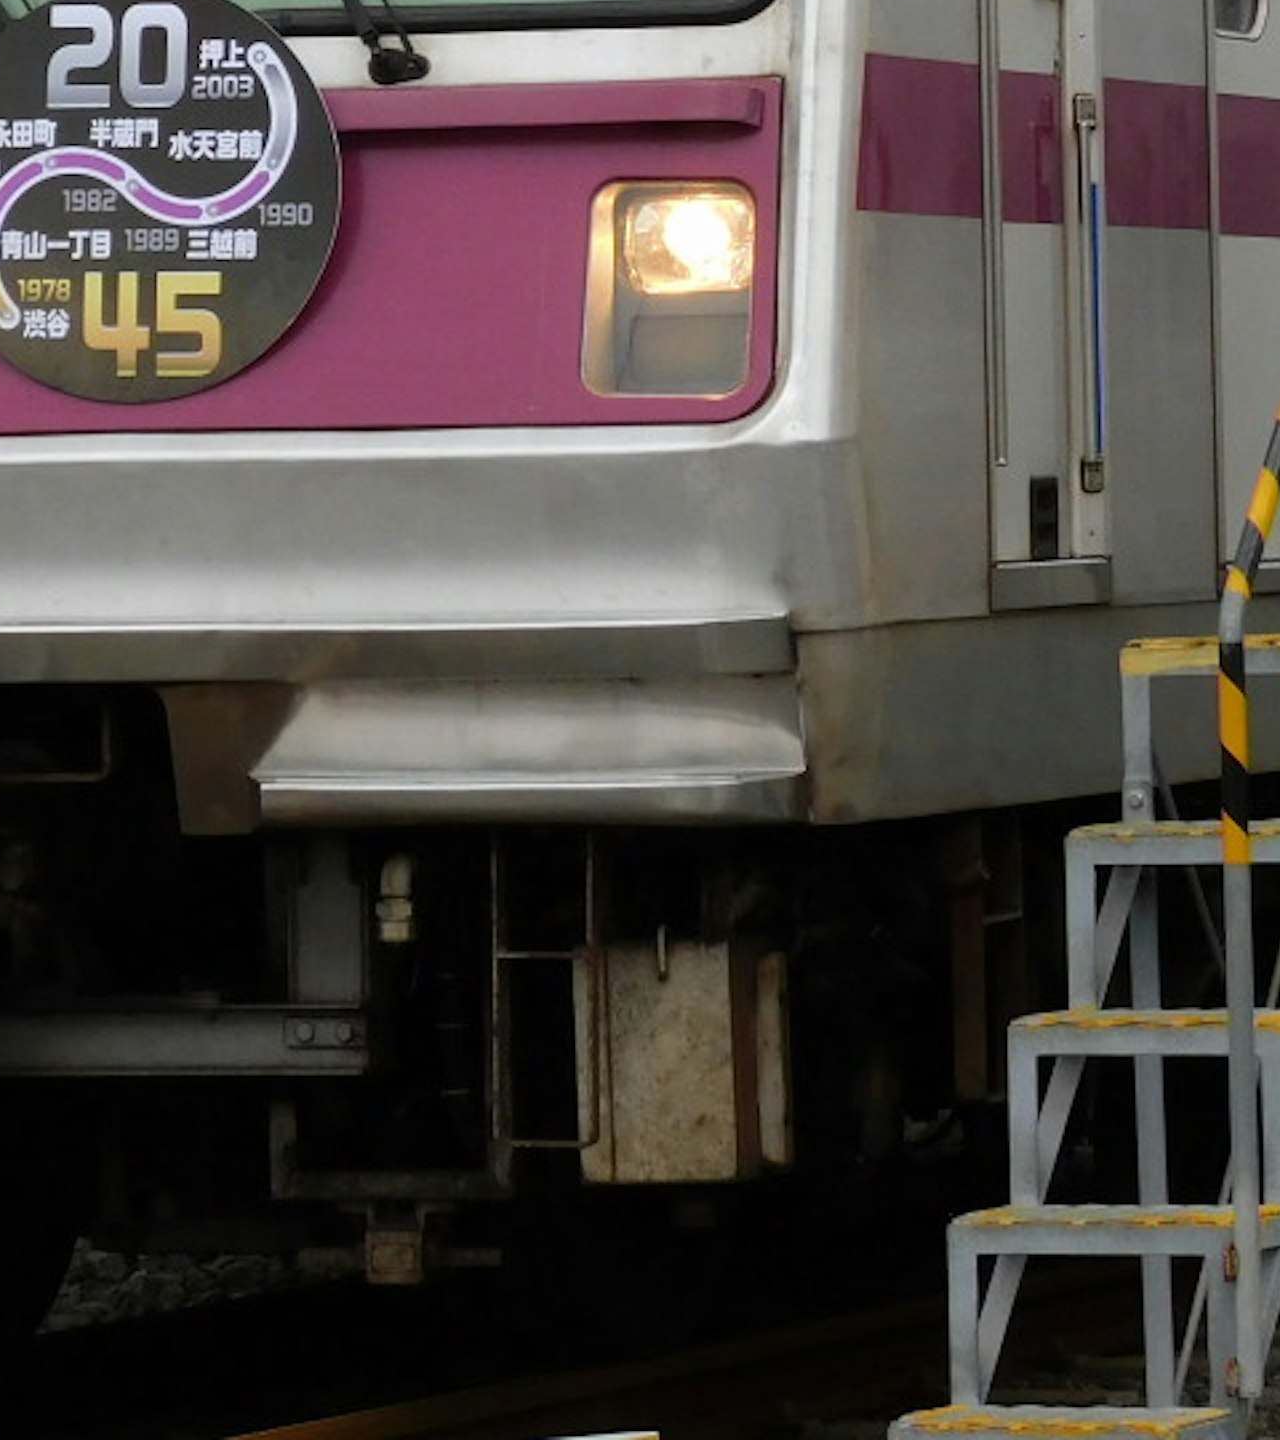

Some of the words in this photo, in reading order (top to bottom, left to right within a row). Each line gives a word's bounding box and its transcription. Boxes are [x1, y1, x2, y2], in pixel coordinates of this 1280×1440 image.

[45, 1, 189, 109] 20
[198, 39, 246, 70] 押上
[191, 74, 255, 100] 2003
[88, 118, 160, 149] 半蔵門
[168, 129, 265, 162] 水天宮前
[62, 189, 117, 213] 1982
[257, 203, 313, 226] 1990
[0, 229, 112, 261] 青山一丁目
[123, 228, 180, 252] 1989
[185, 229, 258, 261] 三越前
[17, 277, 71, 303] 1978
[23, 309, 72, 340] 渋谷
[82, 270, 223, 378] 45
